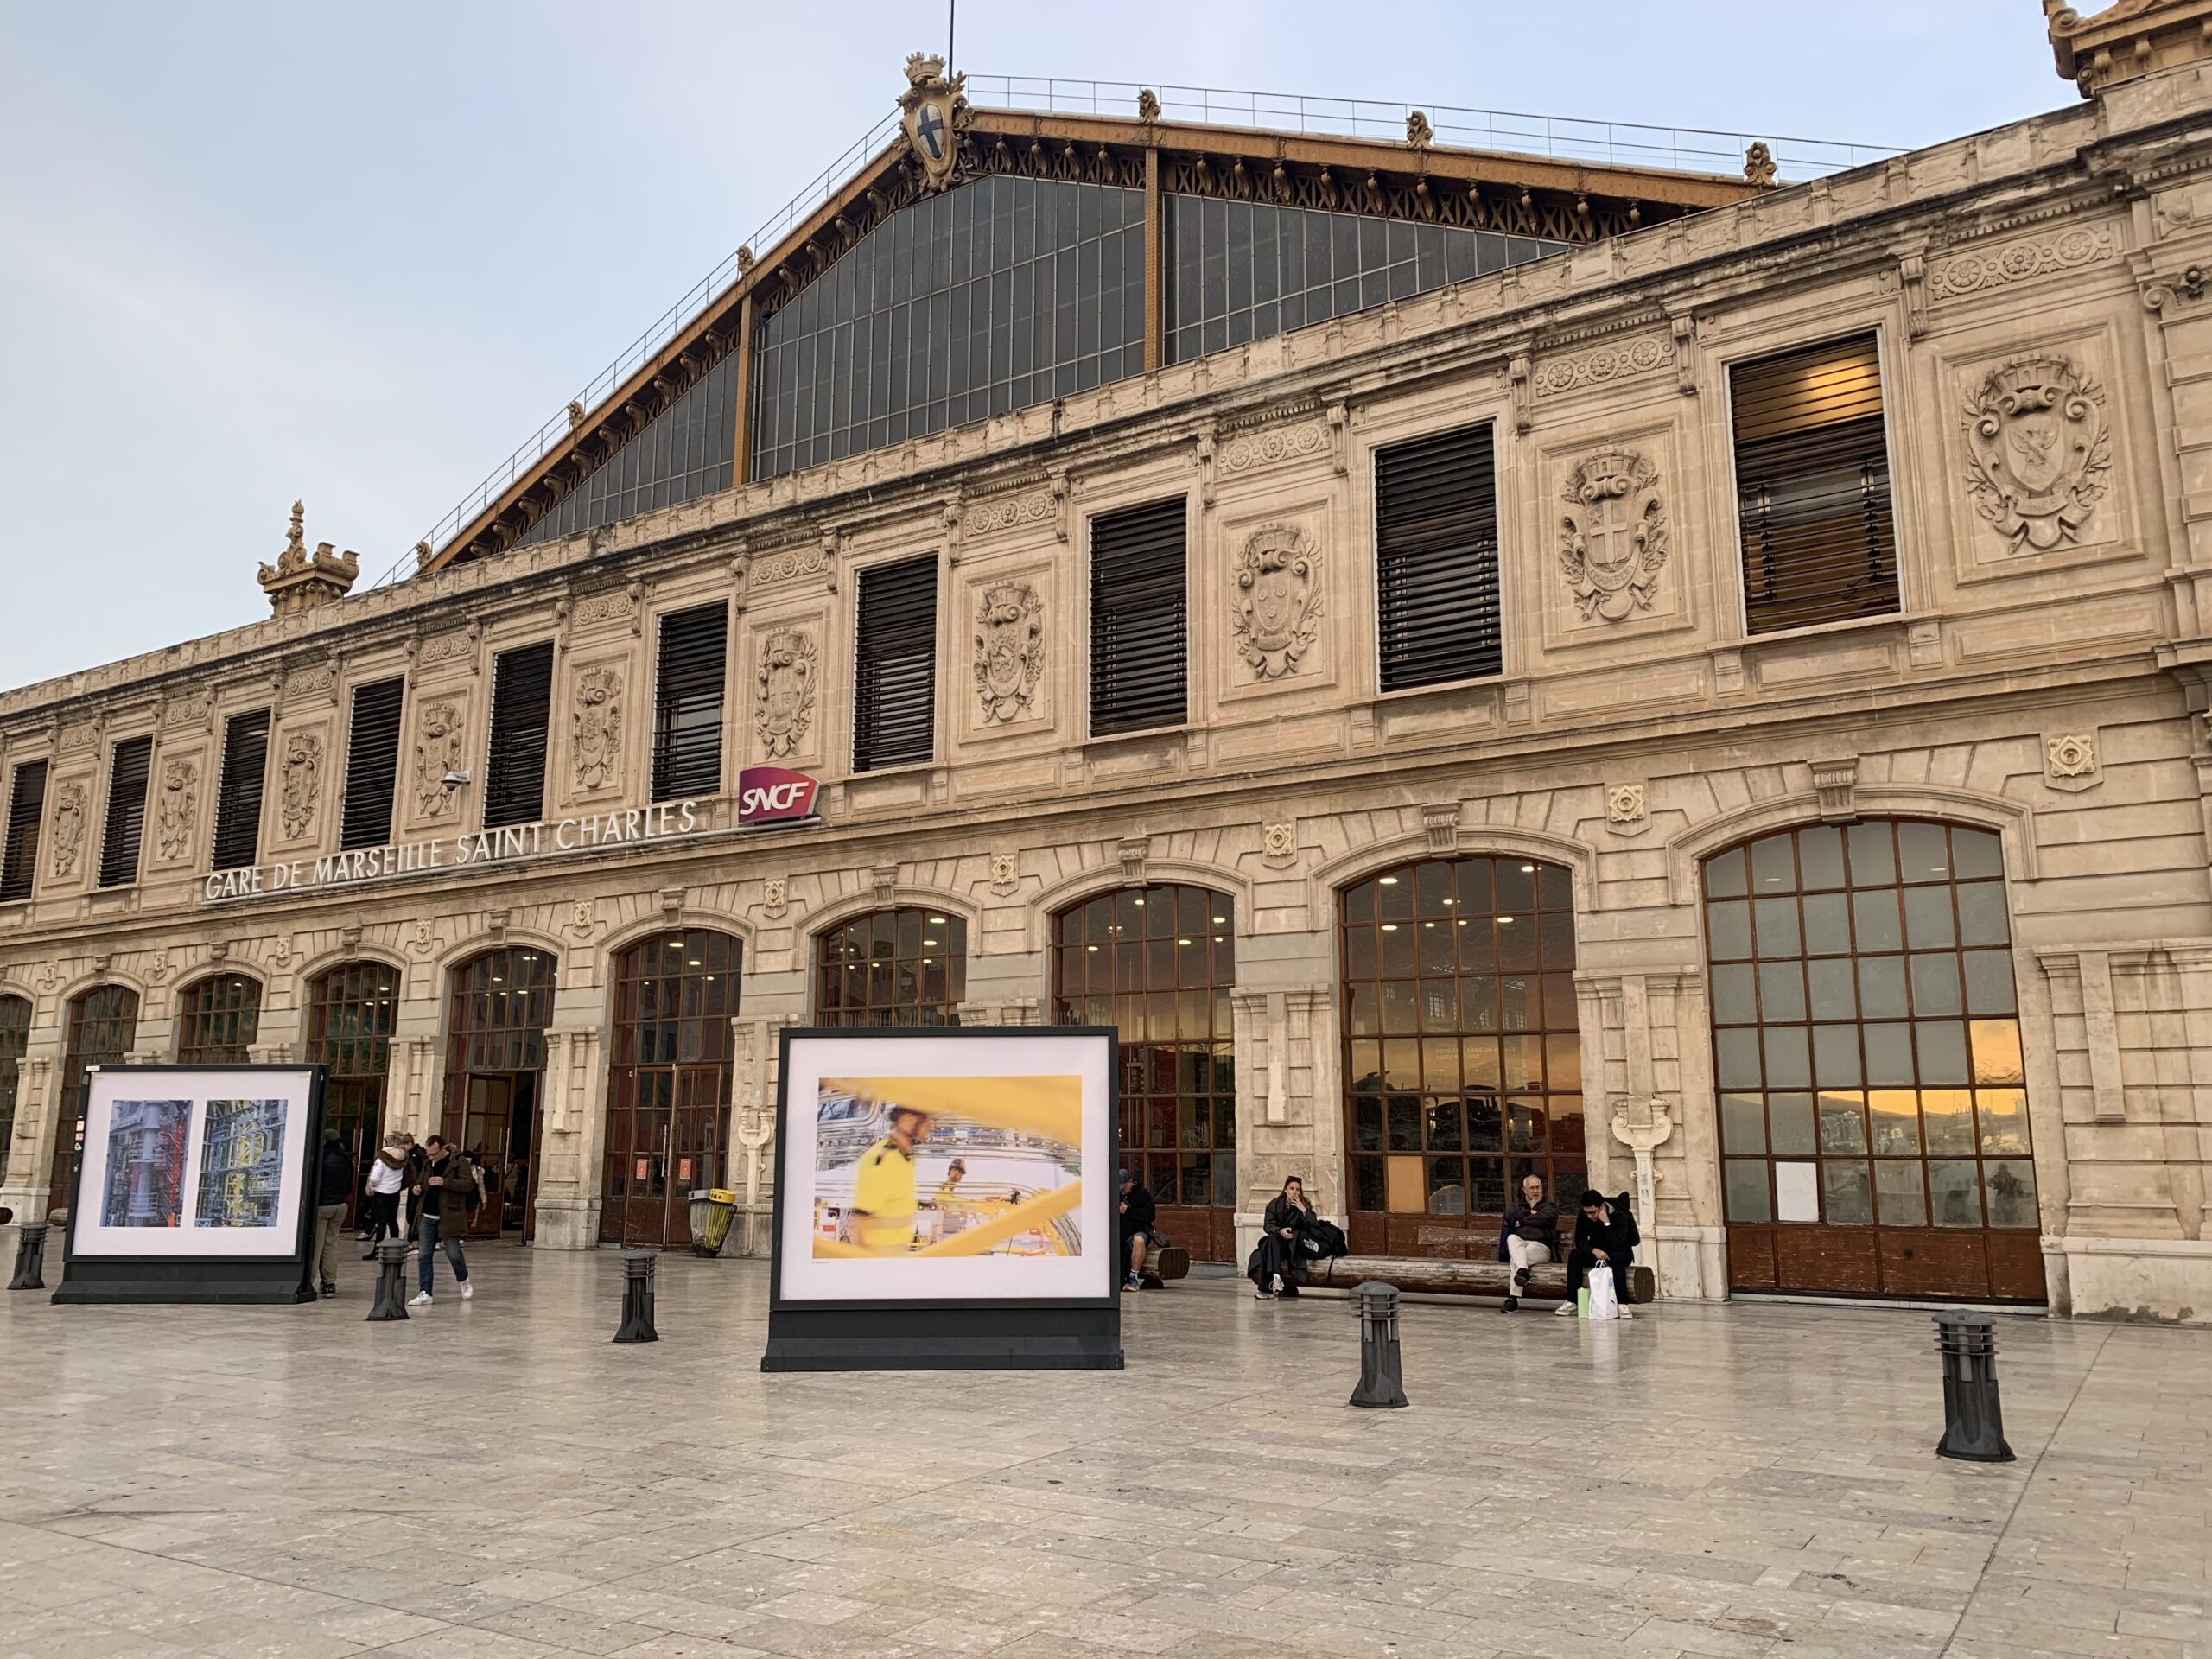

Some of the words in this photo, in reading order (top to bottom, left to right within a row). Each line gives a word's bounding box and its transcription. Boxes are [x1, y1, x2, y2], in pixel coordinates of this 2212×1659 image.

[739, 781, 810, 815] SNCF
[206, 867, 263, 899] GARE
[274, 861, 302, 890] DE
[312, 839, 442, 885] MARSEILLE
[456, 823, 545, 864] SAINT
[556, 801, 698, 849] CHARLES
